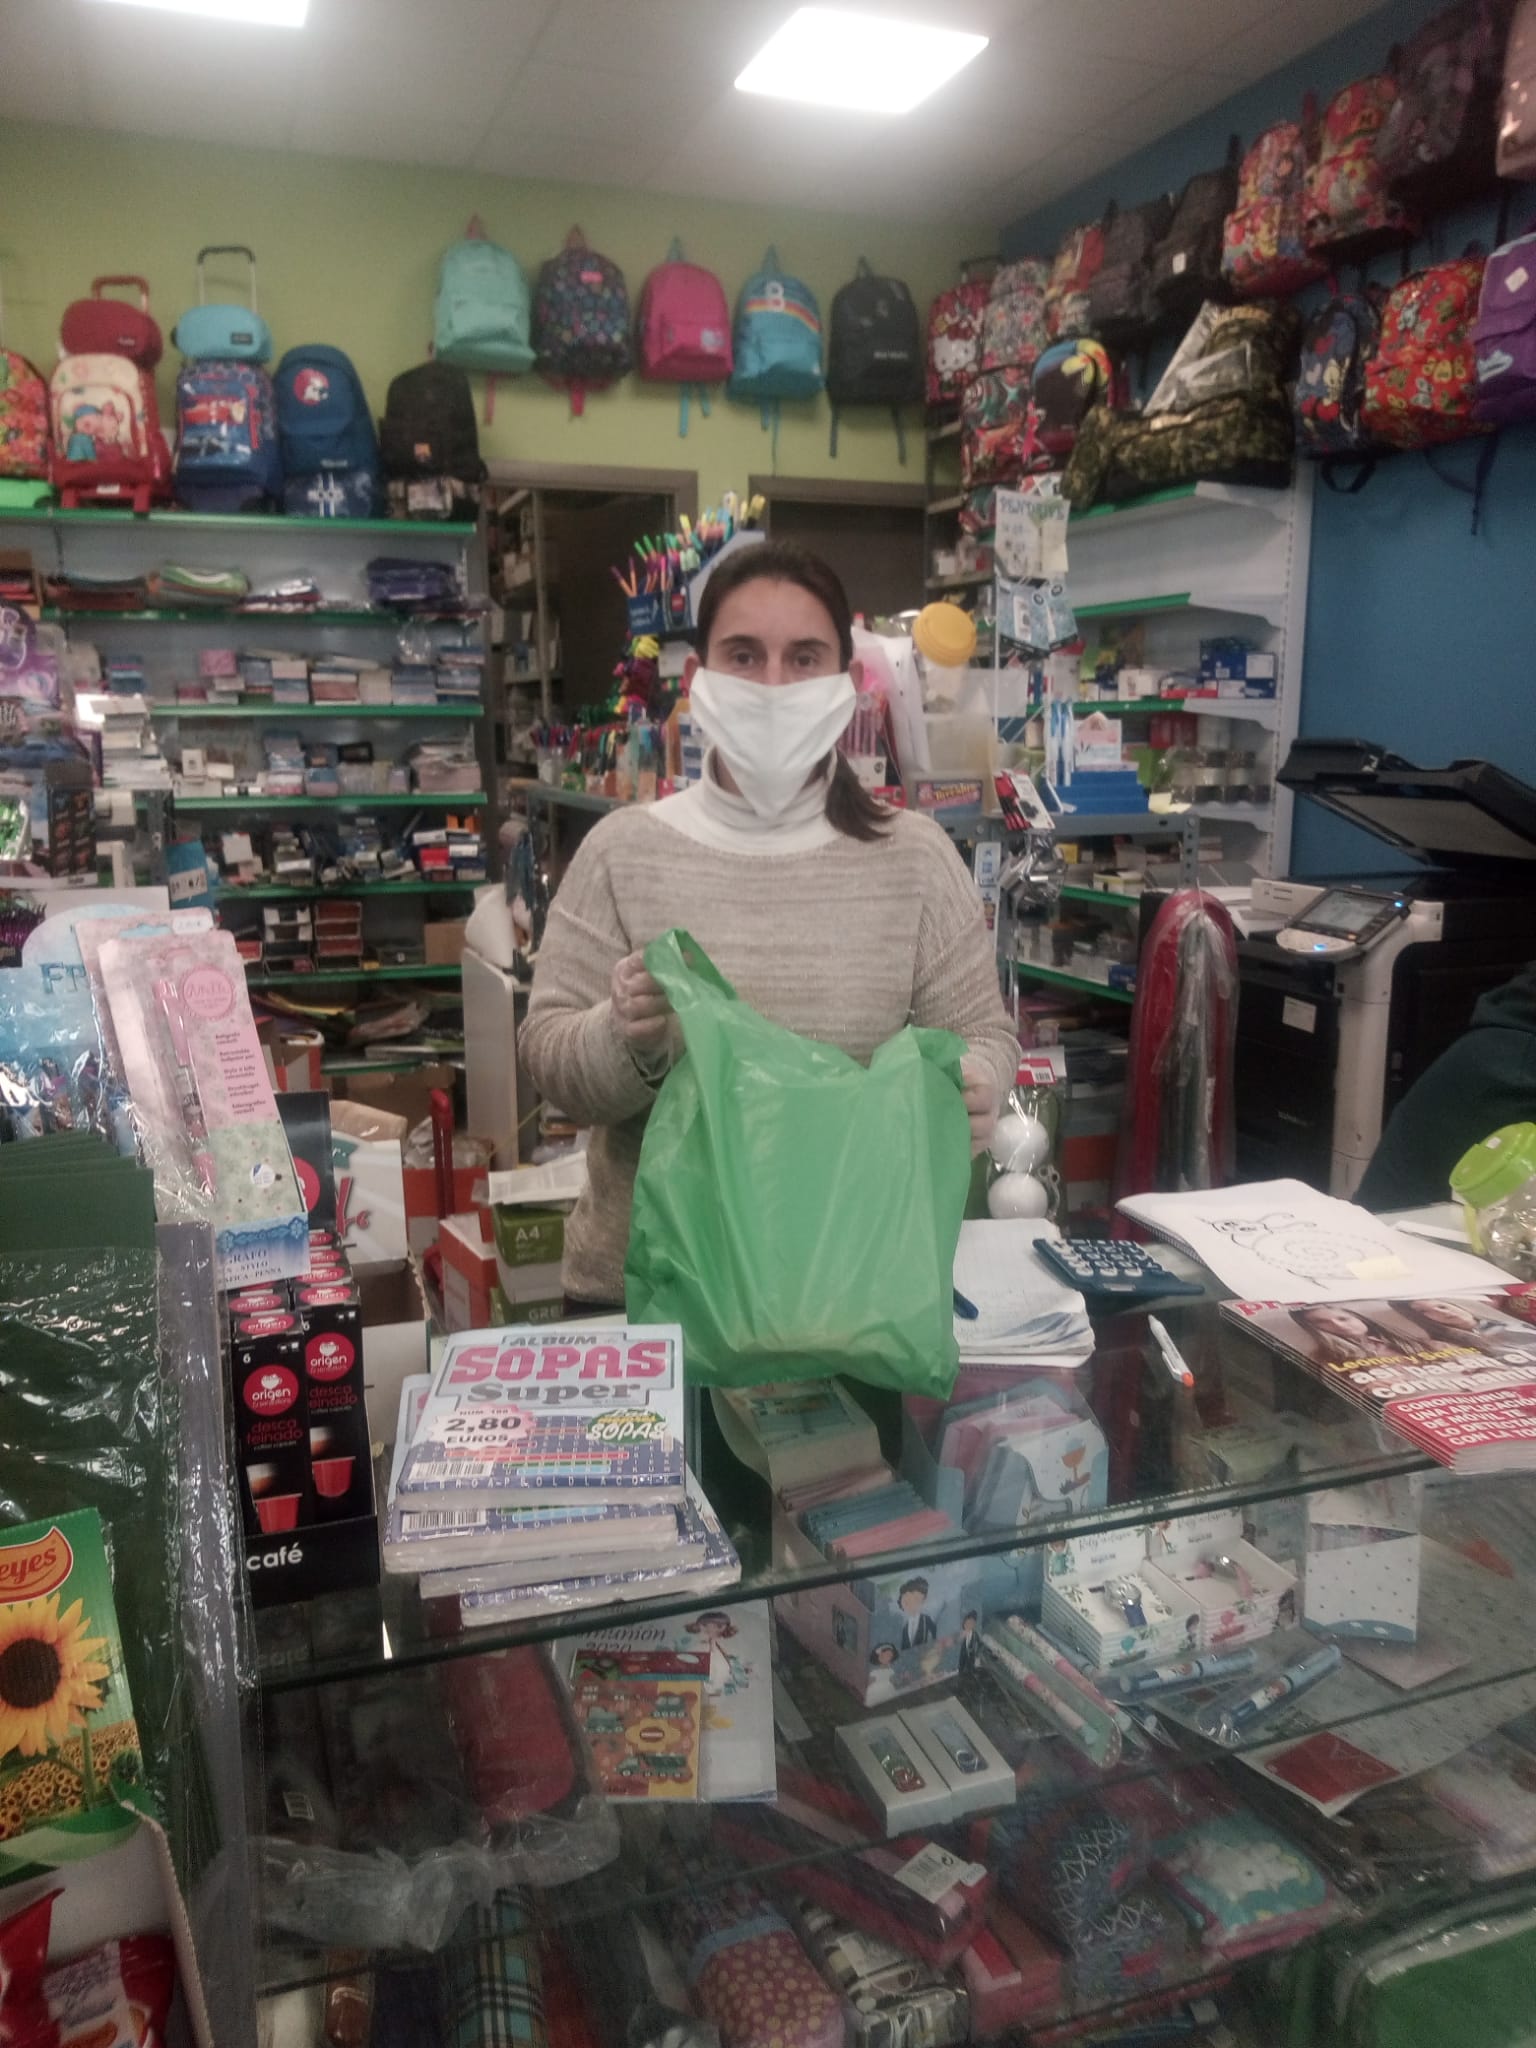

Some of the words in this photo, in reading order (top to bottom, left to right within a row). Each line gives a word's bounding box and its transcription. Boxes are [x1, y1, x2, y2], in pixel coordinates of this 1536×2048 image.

[515, 1225, 541, 1241] A4
[247, 1318, 287, 1331] origen
[509, 1335, 597, 1346] ALBUM
[243, 1353, 251, 1364] 6
[310, 1354, 348, 1368] origen
[448, 1340, 667, 1384] SOPAS
[1327, 1354, 1401, 1373] Leonor
[1404, 1354, 1418, 1364] y
[1399, 1354, 1505, 1378] pasan
[251, 1387, 291, 1402] origen
[466, 1381, 641, 1405] Super
[1409, 1406, 1449, 1421] UNA
[1422, 1418, 1451, 1430] DE
[1500, 1408, 1527, 1419] TE
[444, 1415, 522, 1434] 2,80
[586, 1420, 667, 1441] SOPAS
[1434, 1427, 1462, 1438] LO
[446, 1433, 509, 1444] EUROS
[1448, 1431, 1492, 1446] CON
[1486, 1429, 1516, 1439] LA
[246, 1541, 303, 1571] café
